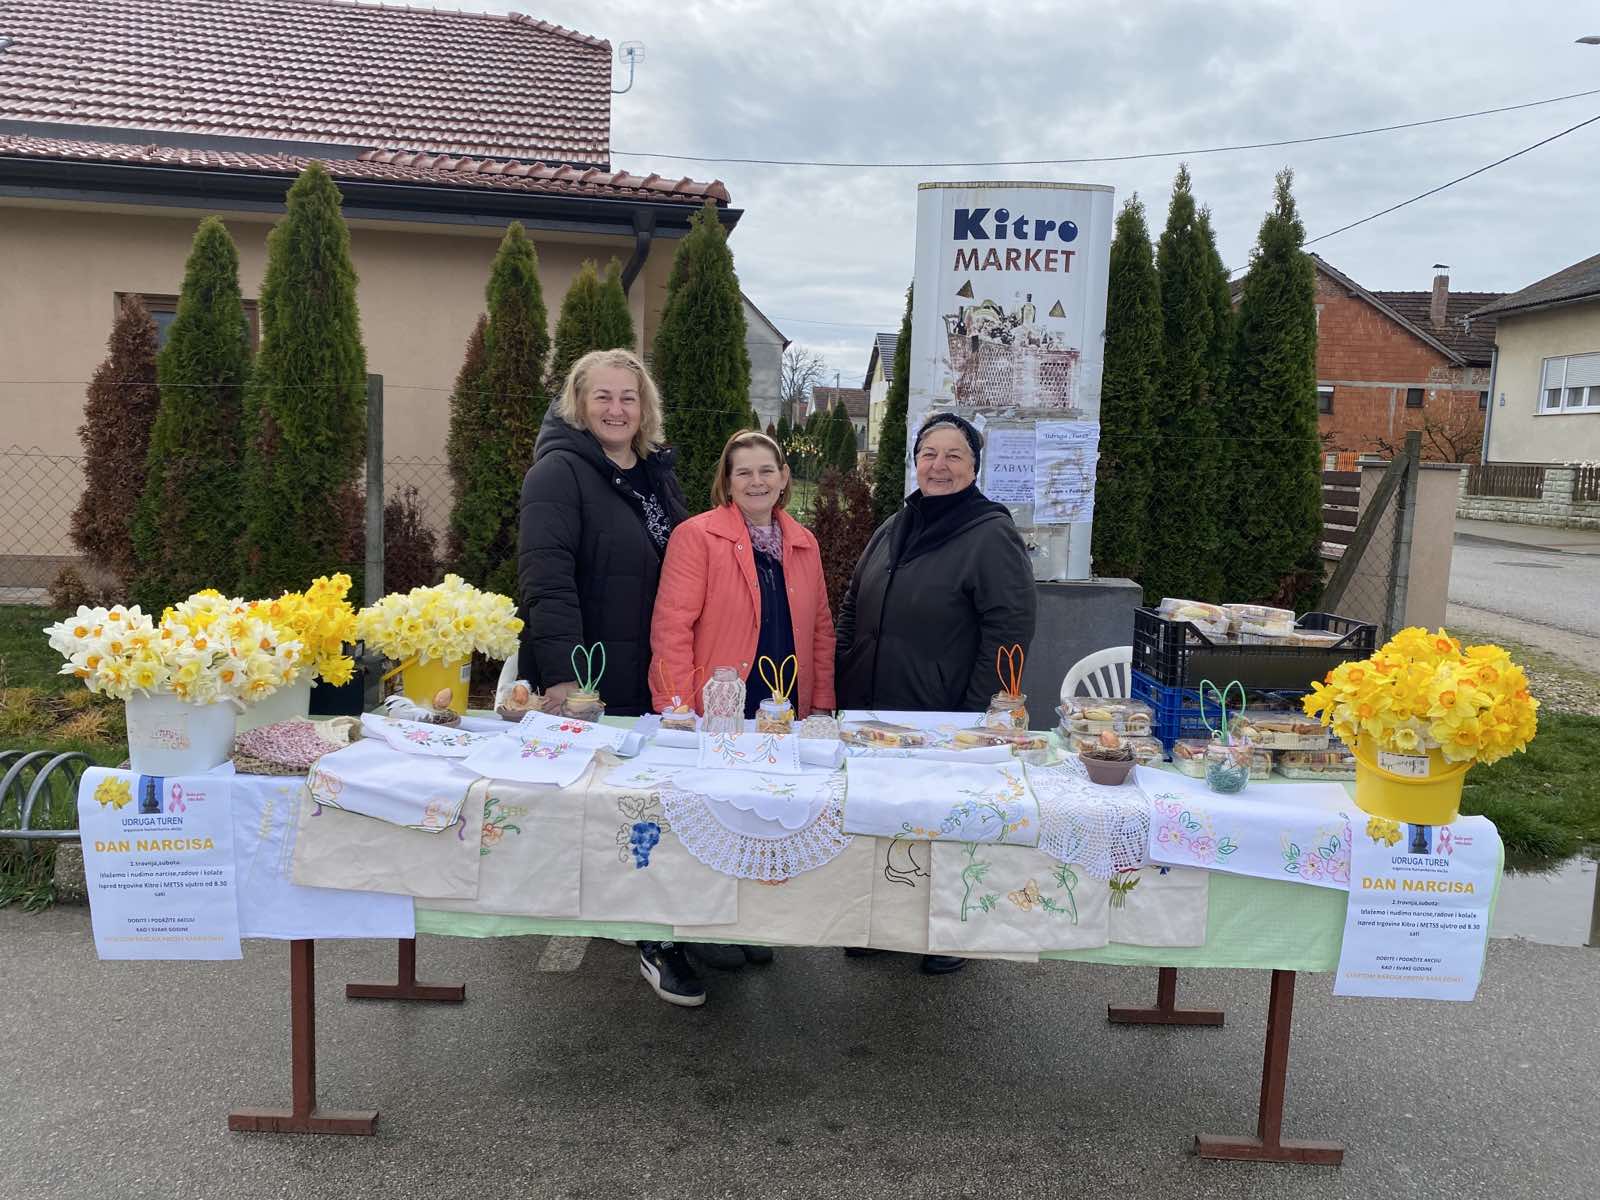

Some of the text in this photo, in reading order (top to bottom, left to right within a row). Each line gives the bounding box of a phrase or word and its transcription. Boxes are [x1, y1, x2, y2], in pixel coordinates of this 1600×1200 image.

[953, 208, 1079, 243] Kitro
[953, 248, 1076, 273] MARKET
[122, 816, 184, 826] UDRUGA TUREN
[94, 838, 215, 853] DAN NARCISA
[1392, 856, 1450, 867] UDRUGA TUREN
[1362, 878, 1475, 894] DAN NARCISA
